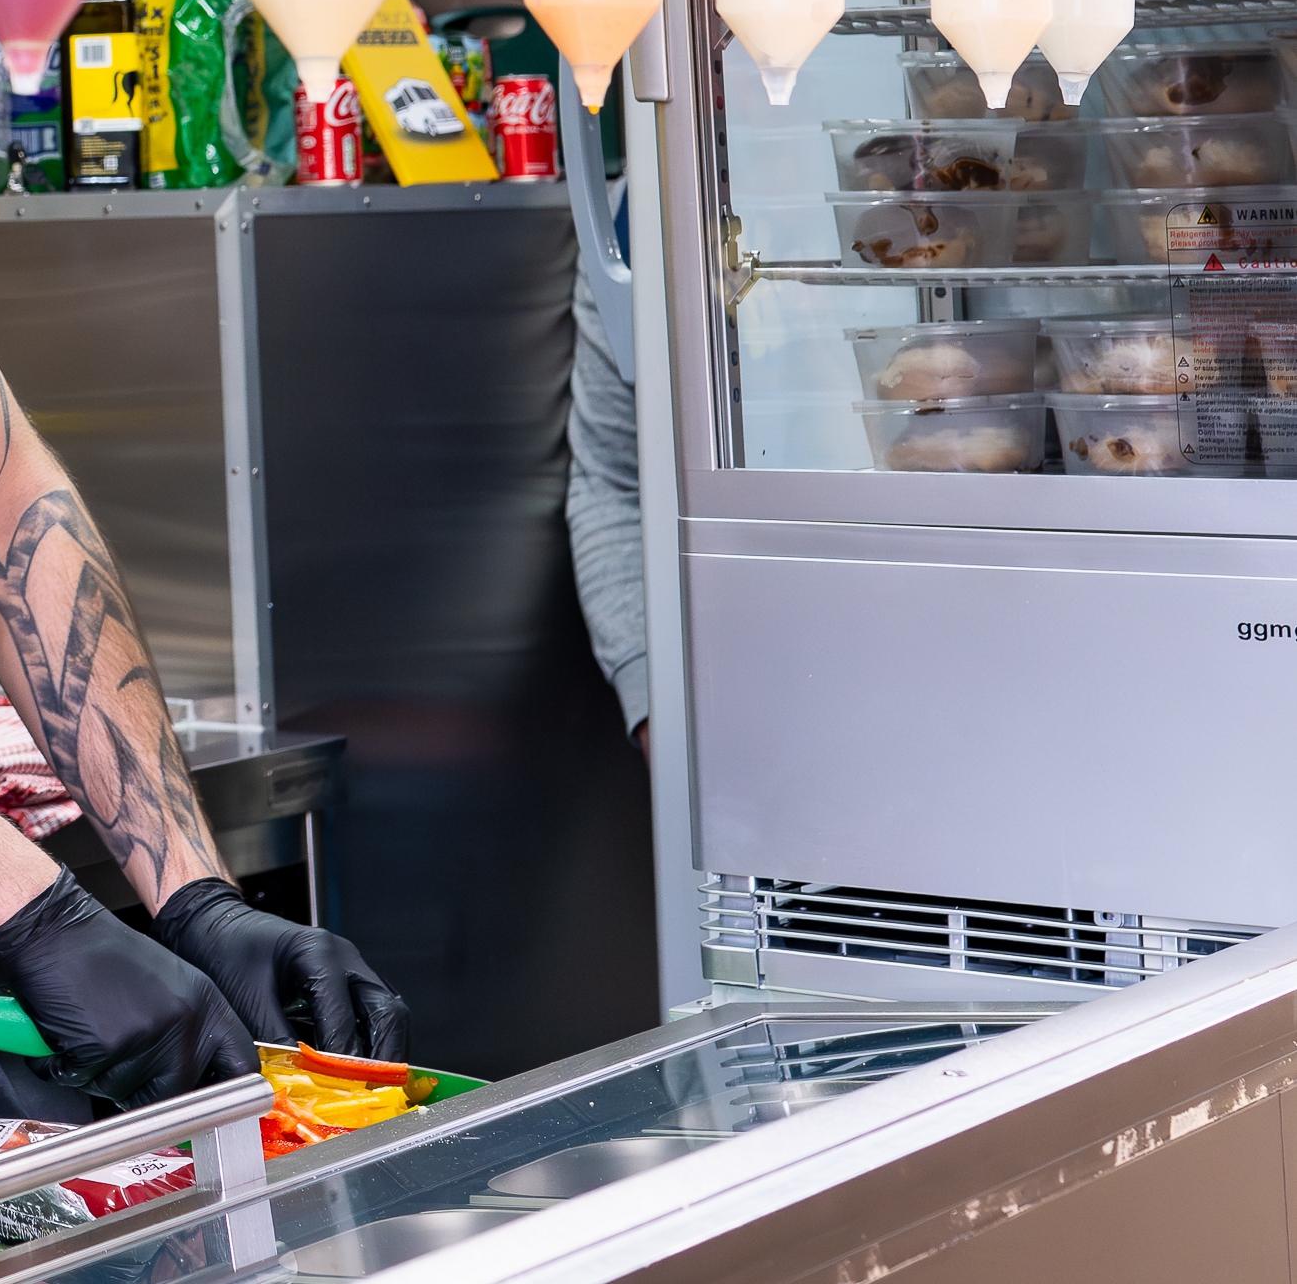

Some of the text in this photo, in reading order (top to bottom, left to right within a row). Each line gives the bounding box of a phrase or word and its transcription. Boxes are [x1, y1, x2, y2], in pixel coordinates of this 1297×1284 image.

[1236, 208, 1297, 221] WARNIN
[1238, 257, 1297, 269] Cautio
[1237, 622, 1297, 642] ggm
